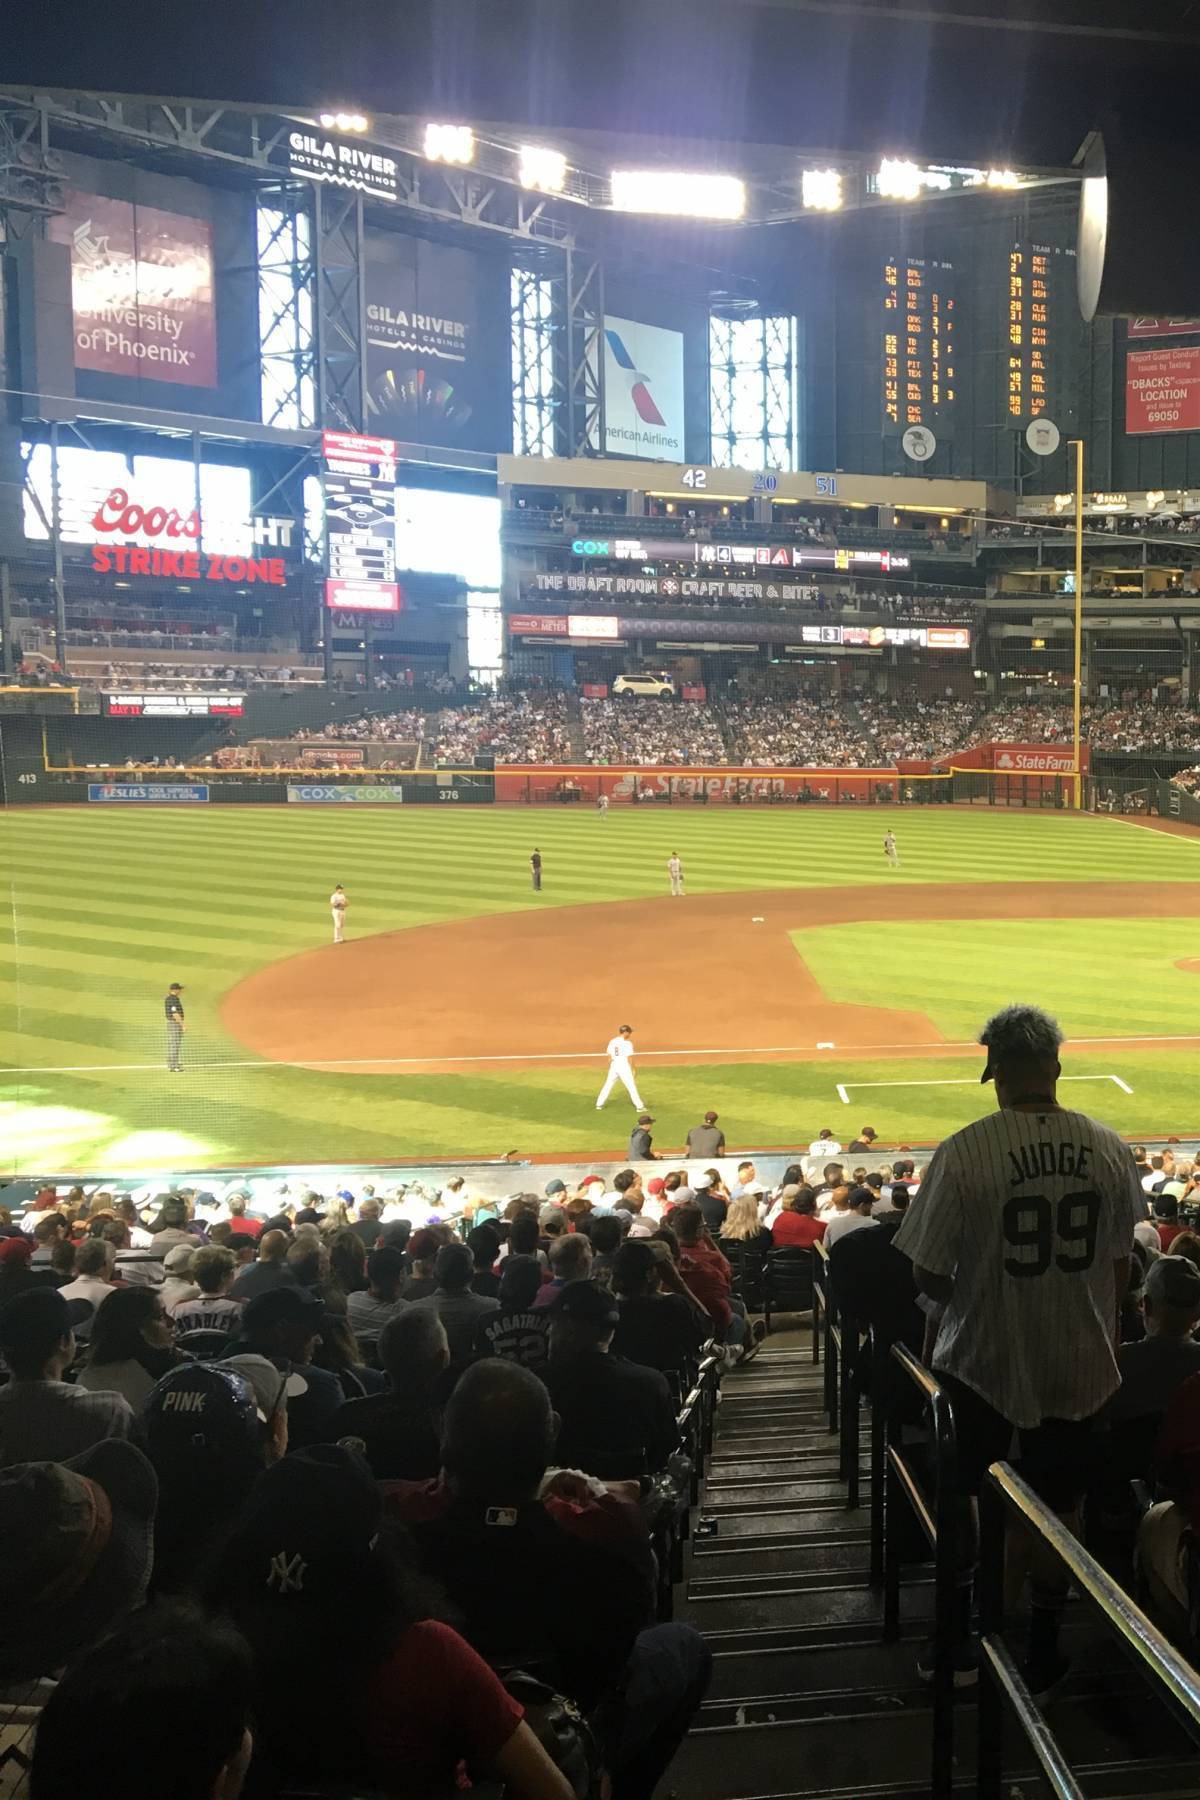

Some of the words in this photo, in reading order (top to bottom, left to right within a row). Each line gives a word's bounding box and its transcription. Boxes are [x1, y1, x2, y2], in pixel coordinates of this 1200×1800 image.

[290, 132, 336, 160] GILA
[339, 145, 396, 175] RIVER
[290, 153, 333, 171] HOTELS
[350, 169, 396, 188] CASINOS
[1032, 245, 1051, 253] TEAM
[907, 258, 925, 266] TEAM
[367, 304, 409, 326] GILA
[412, 313, 465, 338] RIVER
[77, 329, 101, 350] of
[367, 324, 406, 338] HOTELS
[423, 335, 466, 350] CASINOS
[1140, 388, 1188, 402] LOCATION
[1148, 410, 1179, 422] 69050
[643, 433, 679, 449] Airlines
[682, 469, 707, 489] 42
[752, 474, 777, 491] 20
[816, 476, 838, 496] 51
[91, 487, 202, 538] Coors
[572, 540, 609, 555] COX
[91, 545, 200, 579] STRIKE
[206, 553, 286, 585] ZONE
[536, 574, 563, 591] THE
[568, 576, 613, 593] DRAFT
[616, 578, 658, 594] ROOM
[681, 581, 726, 597] CRAFT
[728, 583, 763, 598] BEER
[766, 584, 779, 598] &
[541, 623, 567, 632] METER
[18, 773, 37, 784] 413
[103, 786, 146, 798] LESLIE'S
[302, 786, 336, 800] COX
[355, 787, 390, 800] COX
[439, 790, 459, 800] 376
[1008, 1142, 1093, 1186] JUDGE
[1003, 1191, 1100, 1278] 99
[162, 1391, 206, 1413] PINK
